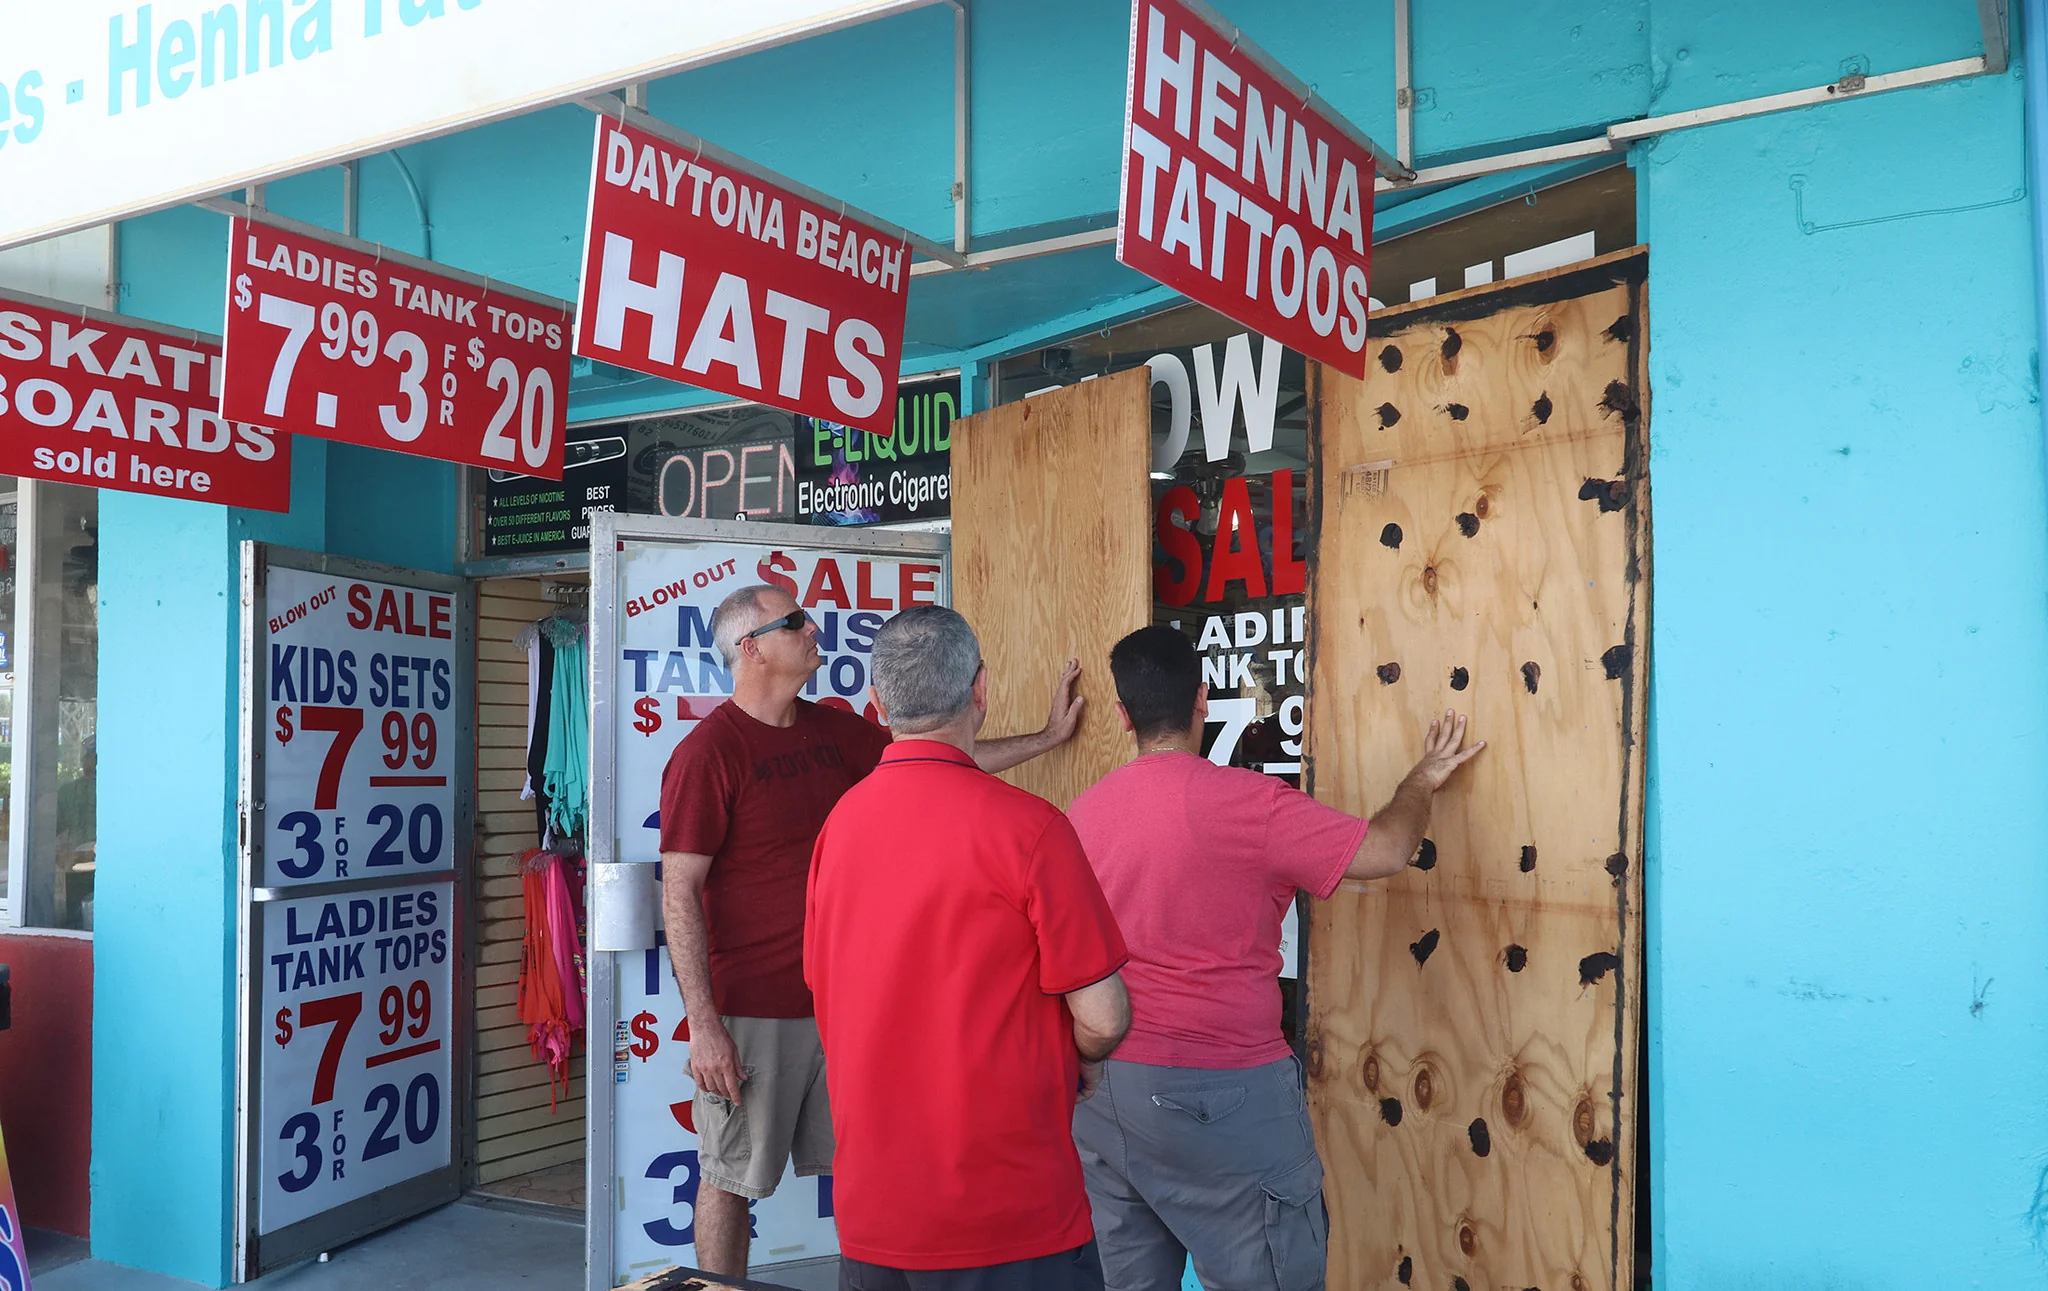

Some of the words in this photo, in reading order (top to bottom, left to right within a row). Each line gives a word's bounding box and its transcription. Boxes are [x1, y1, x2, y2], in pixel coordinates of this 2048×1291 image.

[107, 0, 333, 117] Henna
[1143, 3, 1364, 256] HENNA
[604, 130, 785, 250] DAYTONA
[796, 211, 904, 293] BEACH
[1130, 122, 1368, 353] TATTOOS
[246, 235, 378, 299] LADIES
[389, 277, 478, 328] TANK
[487, 305, 562, 350] TOPS
[593, 231, 885, 419] HATS
[378, 330, 429, 442] 3
[33, 447, 117, 479] sold
[130, 454, 211, 492] here
[499, 497, 509, 507] ALL
[510, 494, 530, 507] LEVELS
[530, 493, 538, 505] OF
[539, 490, 565, 503] NICOTINE
[587, 485, 610, 500] BEST
[658, 444, 795, 519] OPEN
[798, 474, 885, 514] Electronic
[493, 515, 508, 527] OVER
[515, 512, 545, 525] DIFFERENT
[545, 509, 571, 522] FLAVORS
[497, 534, 511, 546] BEST
[533, 531, 540, 543] IN
[540, 529, 566, 542] AMERICA
[1155, 468, 1306, 608] SAL
[268, 602, 308, 635] BLOW
[310, 585, 337, 611] OUT
[346, 583, 452, 640] SALE
[626, 579, 687, 618] BLOW
[693, 558, 736, 588] OUT
[757, 552, 935, 611] SALE
[678, 605, 885, 653] MNS
[271, 643, 358, 706] KIDS
[369, 652, 451, 711] SETS
[623, 649, 734, 694] TAN
[1202, 653, 1257, 690] NK
[276, 810, 325, 879] 3
[365, 803, 443, 868] 20
[287, 890, 438, 945] LADIES
[271, 942, 364, 992] TANK
[375, 929, 447, 974] TOPS
[277, 1112, 323, 1193] 3
[361, 1072, 440, 1162] 20
